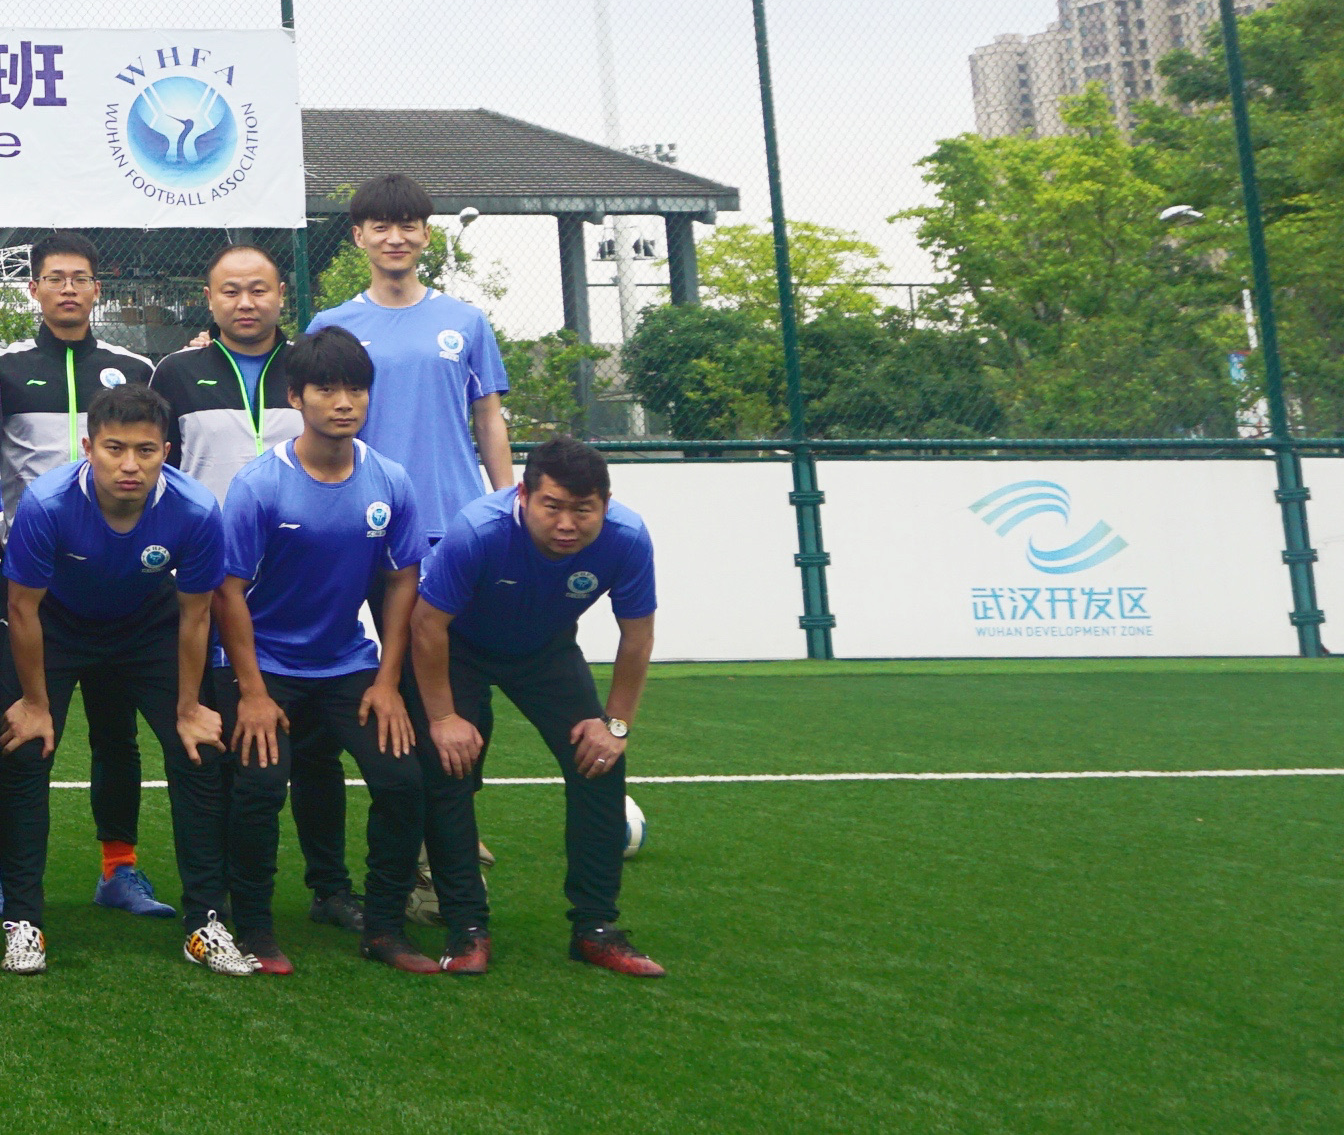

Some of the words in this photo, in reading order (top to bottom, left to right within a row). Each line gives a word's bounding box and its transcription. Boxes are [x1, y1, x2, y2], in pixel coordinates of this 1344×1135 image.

[115, 46, 234, 86] WHFA
[105, 102, 129, 168] WUHAN
[124, 168, 207, 207] FOOTBALL
[211, 102, 259, 202] ASSOCIATION
[971, 587, 1151, 620] 武汉开发区
[975, 626, 1022, 637] WUHAN
[1026, 626, 1117, 637] DEVELOPMENT
[1121, 625, 1153, 636] ZONE
